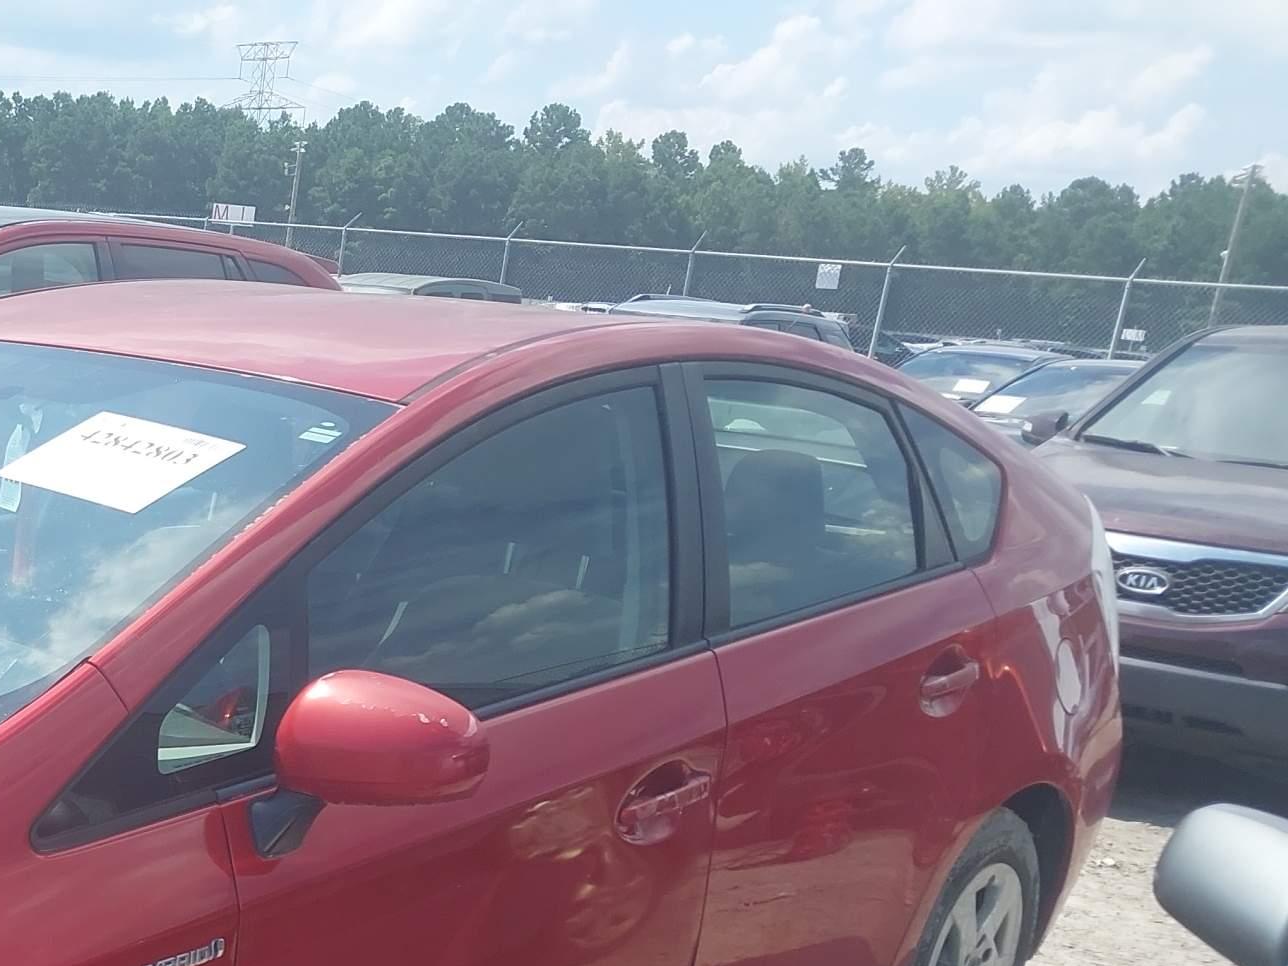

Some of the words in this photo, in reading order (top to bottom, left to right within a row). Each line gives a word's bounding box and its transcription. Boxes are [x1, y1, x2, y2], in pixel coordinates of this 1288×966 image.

[213, 204, 229, 220] M
[80, 429, 199, 465] 42842803
[1125, 573, 1159, 589] KIA
